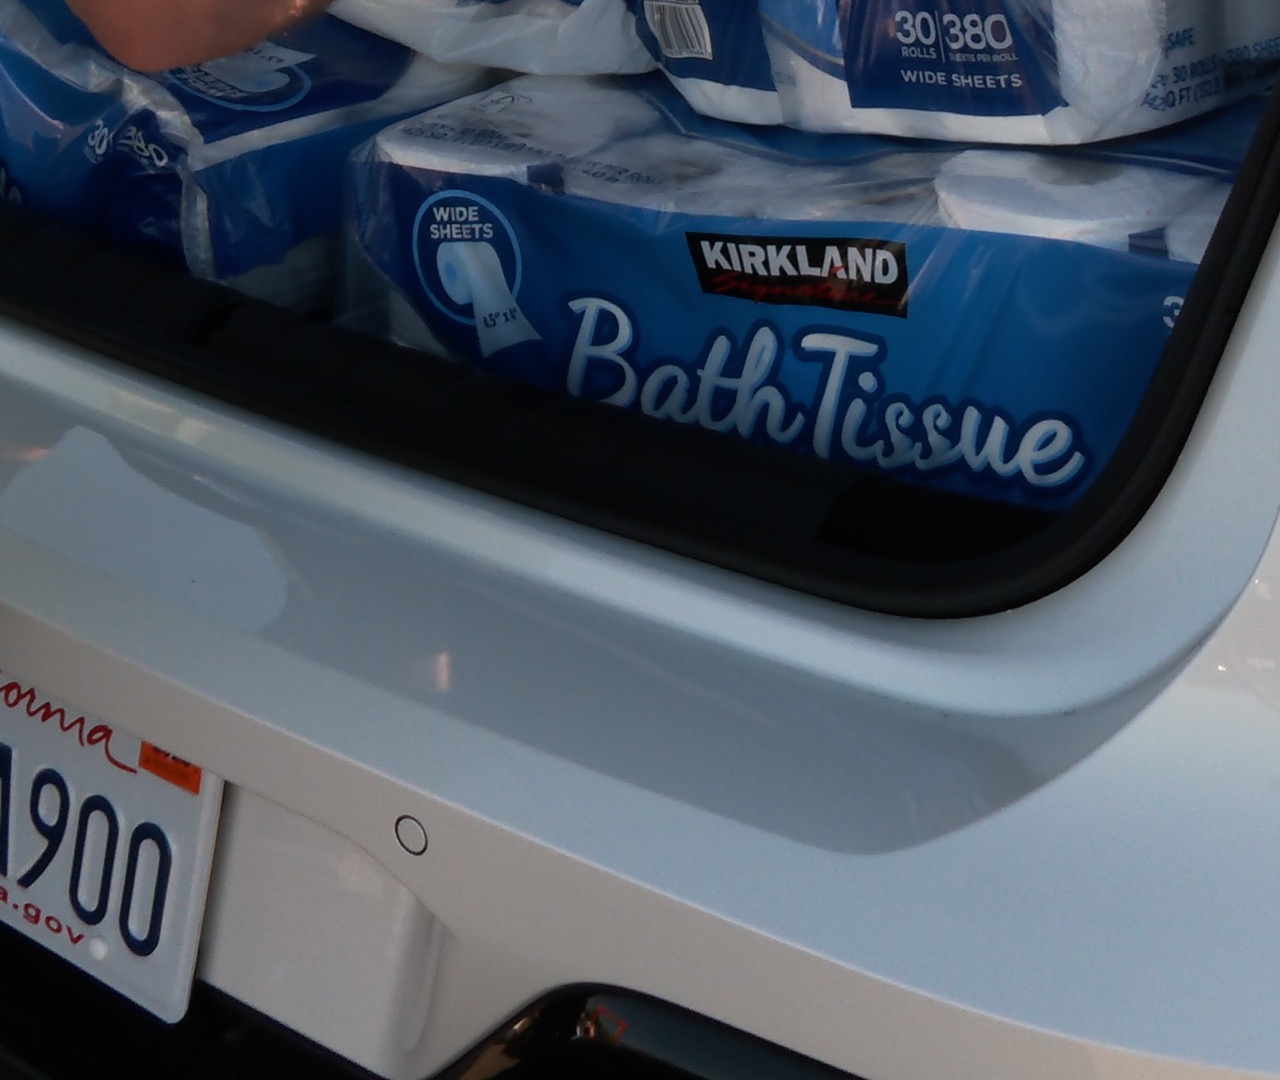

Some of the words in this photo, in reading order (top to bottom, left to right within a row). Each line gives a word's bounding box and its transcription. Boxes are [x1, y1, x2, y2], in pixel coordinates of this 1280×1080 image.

[894, 10, 936, 45] 30
[942, 13, 1013, 50] 380
[901, 46, 937, 59] ROLLS
[900, 69, 947, 85] WIDE
[951, 72, 1023, 88] SHEETS
[433, 206, 479, 222] WIDE
[429, 223, 494, 239] SHEETS
[700, 240, 898, 284] KIRKLAND
[566, 296, 805, 445] Bath
[799, 332, 1086, 487] Tissue
